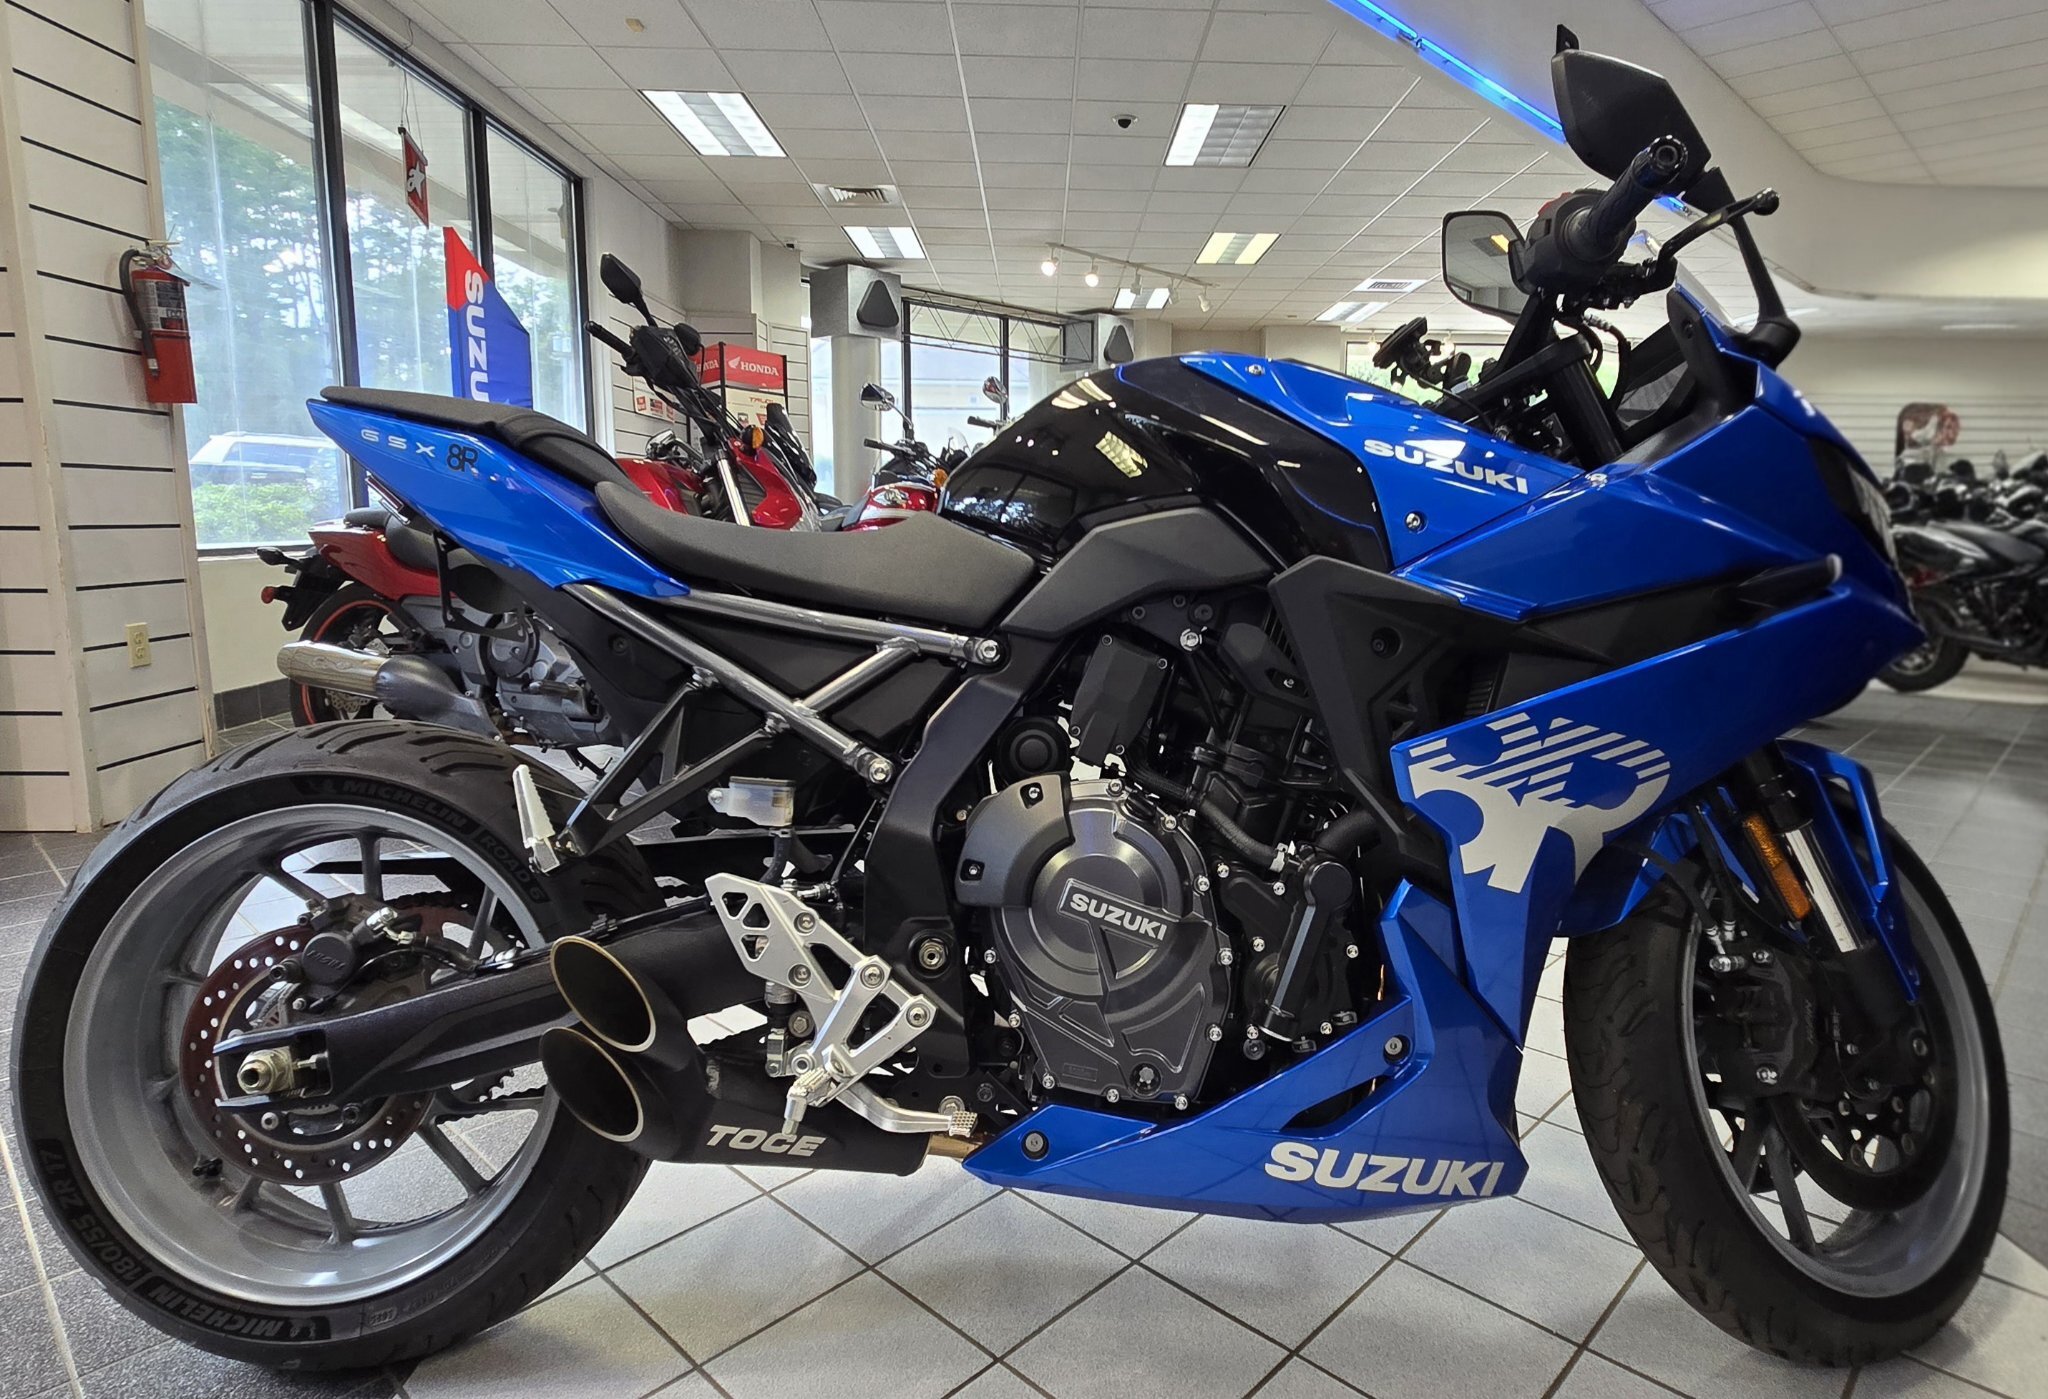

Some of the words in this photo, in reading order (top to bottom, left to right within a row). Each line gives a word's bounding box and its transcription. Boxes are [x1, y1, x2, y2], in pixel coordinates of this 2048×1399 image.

[741, 362, 779, 376] HONDA
[446, 443, 478, 472] 8R
[1363, 438, 1529, 495] SUZUKI
[343, 781, 465, 829] MICHELIN
[480, 833, 533, 884] ROAD
[1070, 893, 1167, 940] SUZUKI
[707, 1125, 826, 1156] TOCE
[1264, 1142, 1504, 1197] SUZUKI
[71, 1212, 144, 1284] 180/55
[148, 1282, 284, 1338] MICHELIN
